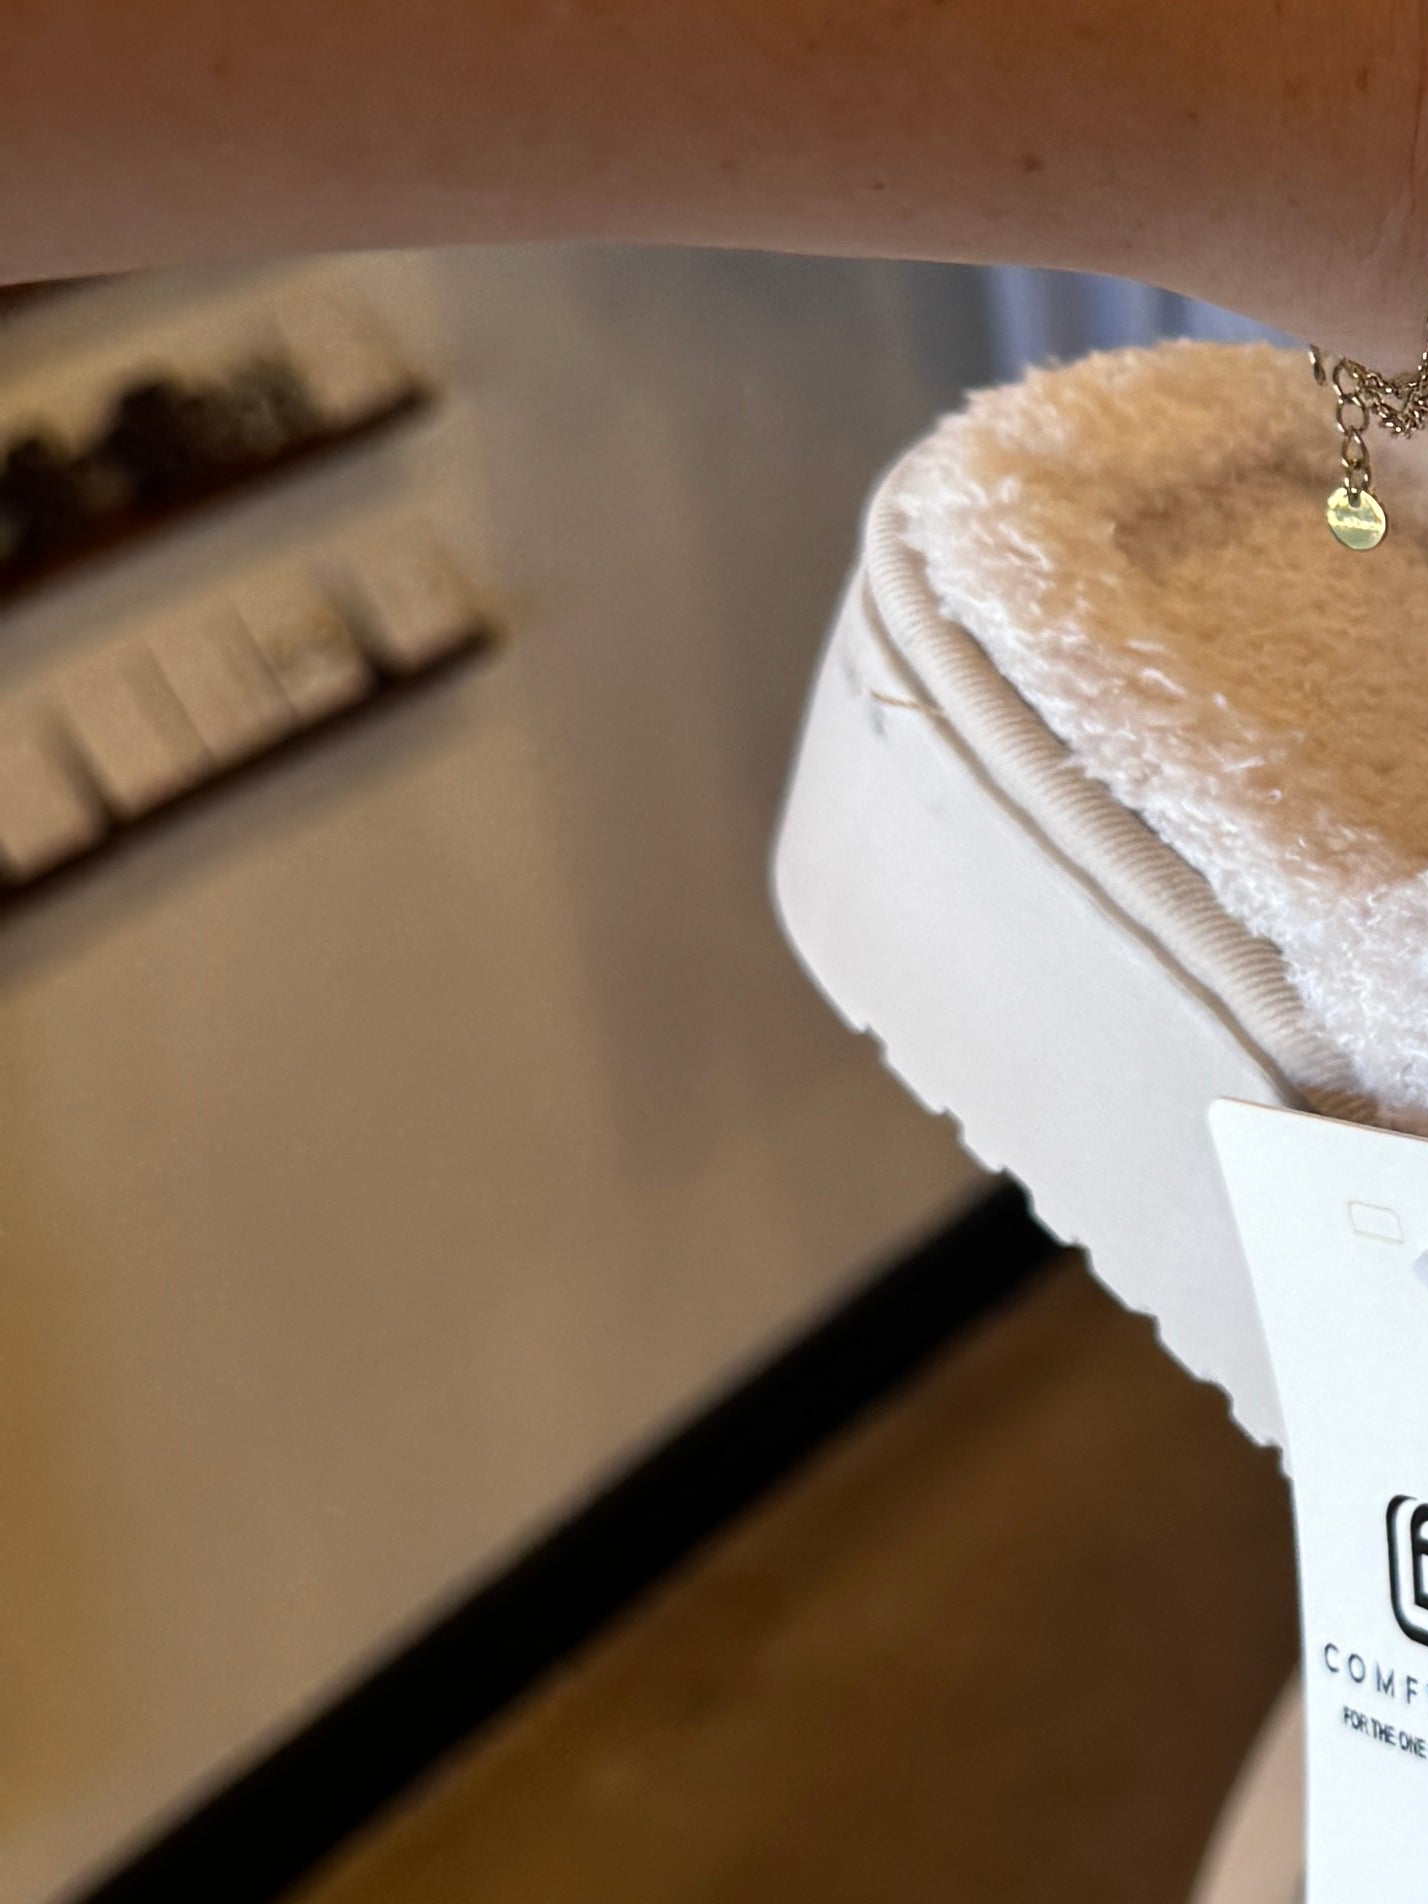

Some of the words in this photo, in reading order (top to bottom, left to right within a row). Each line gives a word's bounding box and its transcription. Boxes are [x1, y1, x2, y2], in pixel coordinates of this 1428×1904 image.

[1343, 1706, 1370, 1736] FOR
[1371, 1717, 1396, 1746] THE
[1398, 1731, 1426, 1760] ONE
